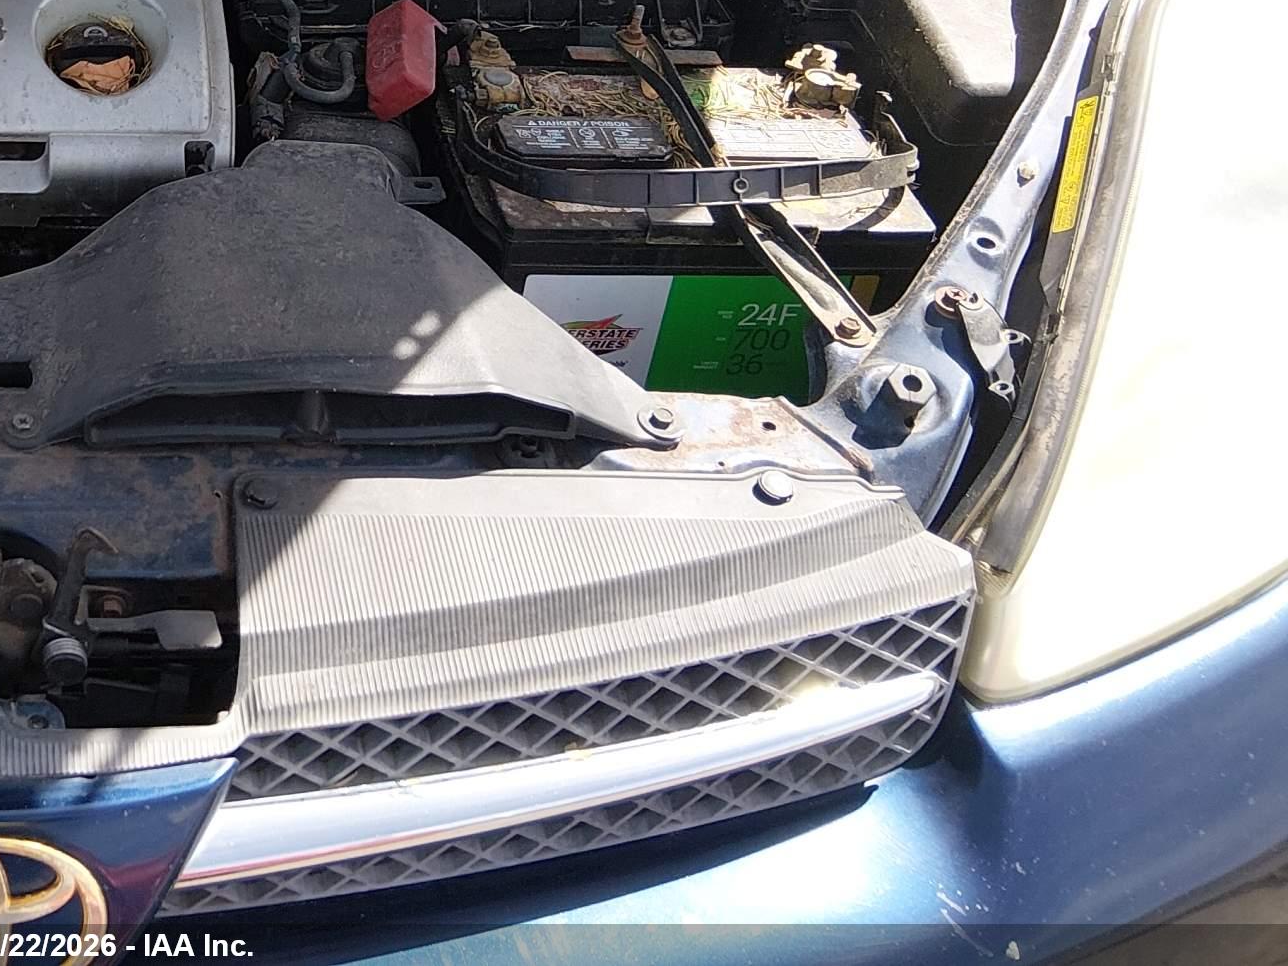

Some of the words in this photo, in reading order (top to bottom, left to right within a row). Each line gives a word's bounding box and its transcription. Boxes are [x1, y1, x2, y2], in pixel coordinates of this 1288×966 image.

[737, 303, 802, 326] 24F
[567, 329, 637, 339] ERSTATE
[733, 327, 791, 351] 700
[726, 353, 763, 376] 36
